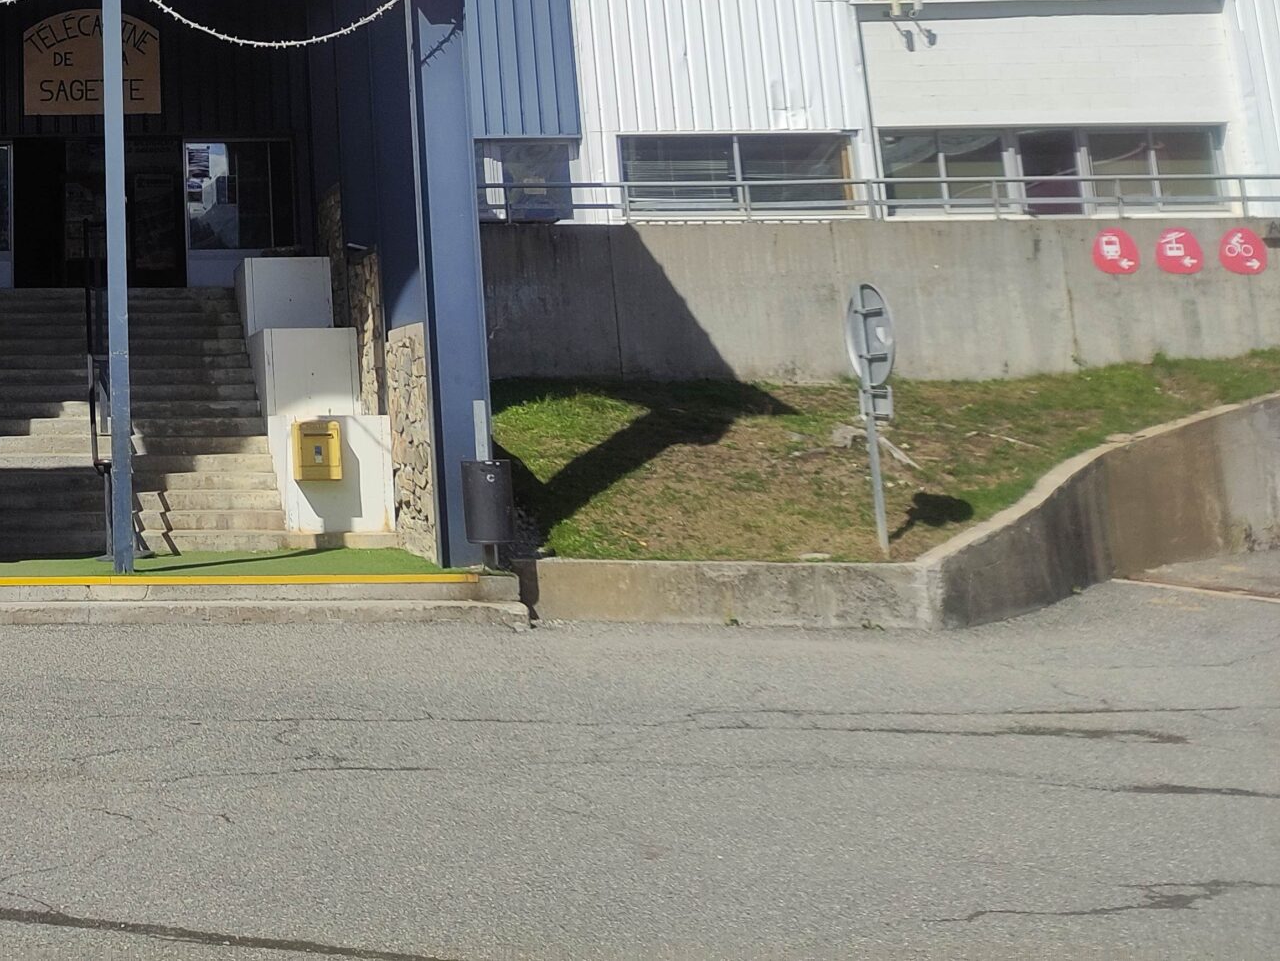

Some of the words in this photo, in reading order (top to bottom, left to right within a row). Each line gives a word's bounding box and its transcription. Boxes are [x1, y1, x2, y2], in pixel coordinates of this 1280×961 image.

[24, 14, 158, 54] TÉLÉCAINE
[53, 51, 74, 67] DE
[39, 78, 145, 102] SAGEE
